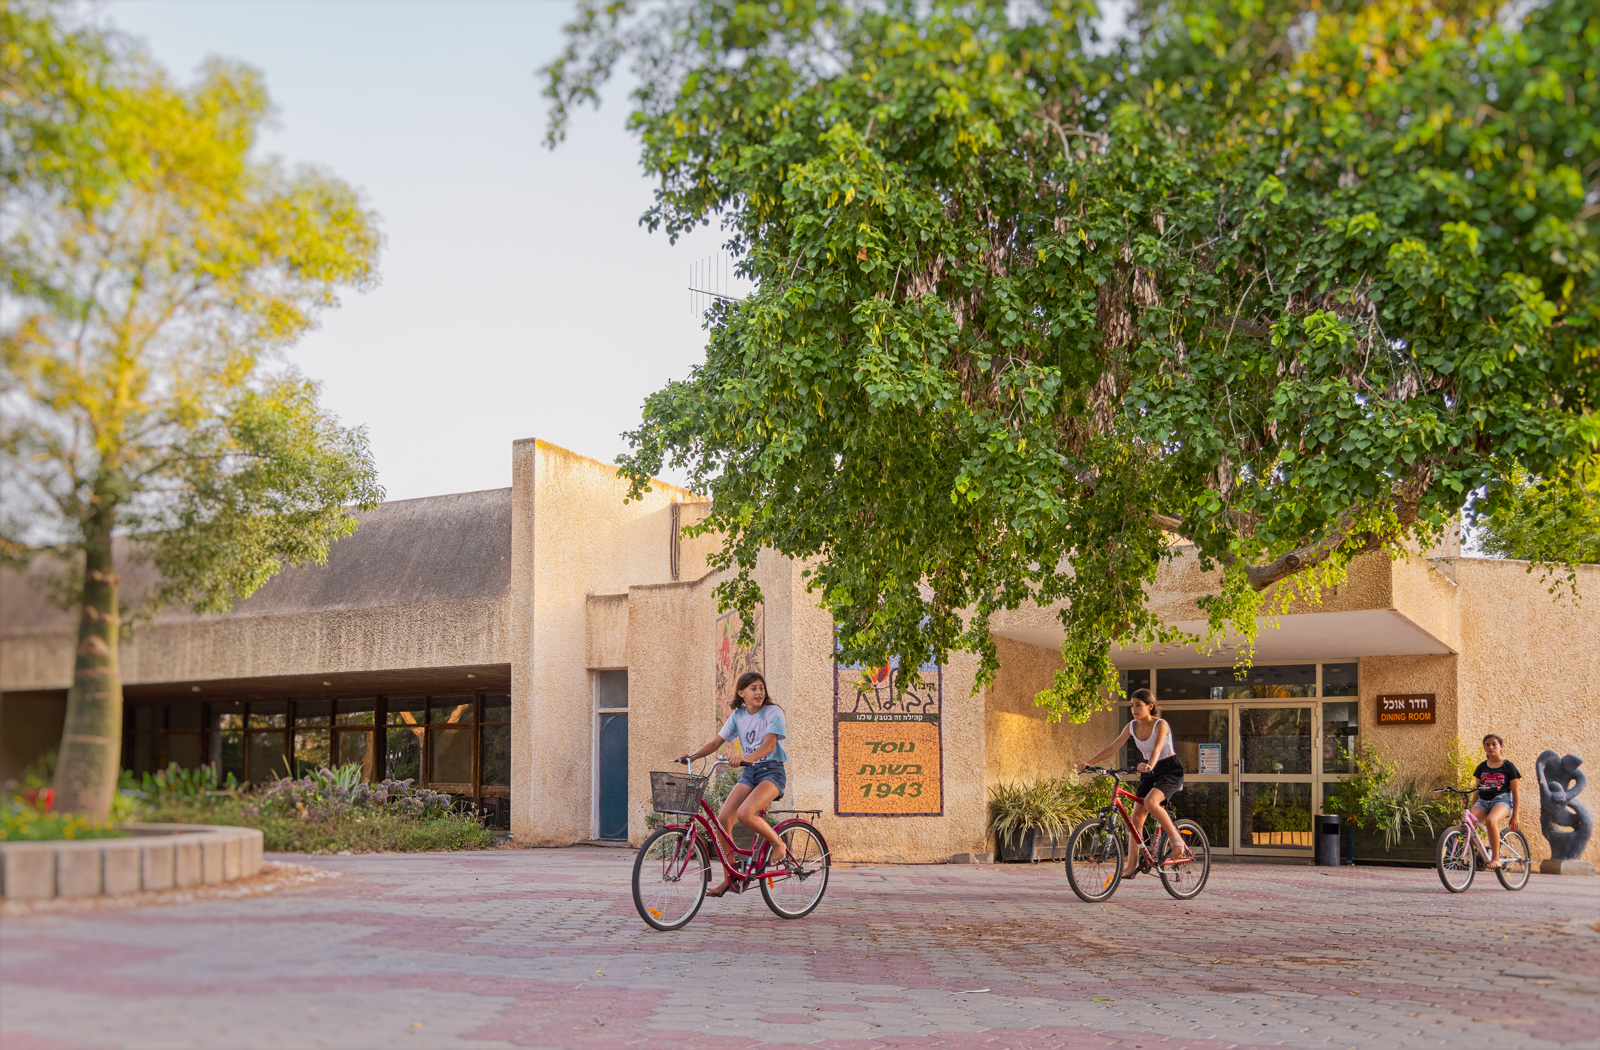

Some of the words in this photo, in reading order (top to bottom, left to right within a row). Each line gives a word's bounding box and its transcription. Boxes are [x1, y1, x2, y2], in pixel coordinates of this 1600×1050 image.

[1383, 697, 1405, 710] אוכל
[1408, 698, 1428, 709] חדר
[874, 714, 893, 722] בטבע
[1381, 712, 1406, 721] DINING
[1408, 712, 1431, 721] ROOM
[865, 741, 915, 754] נוסד
[856, 764, 923, 776] בשנת
[859, 782, 923, 799] 1943
